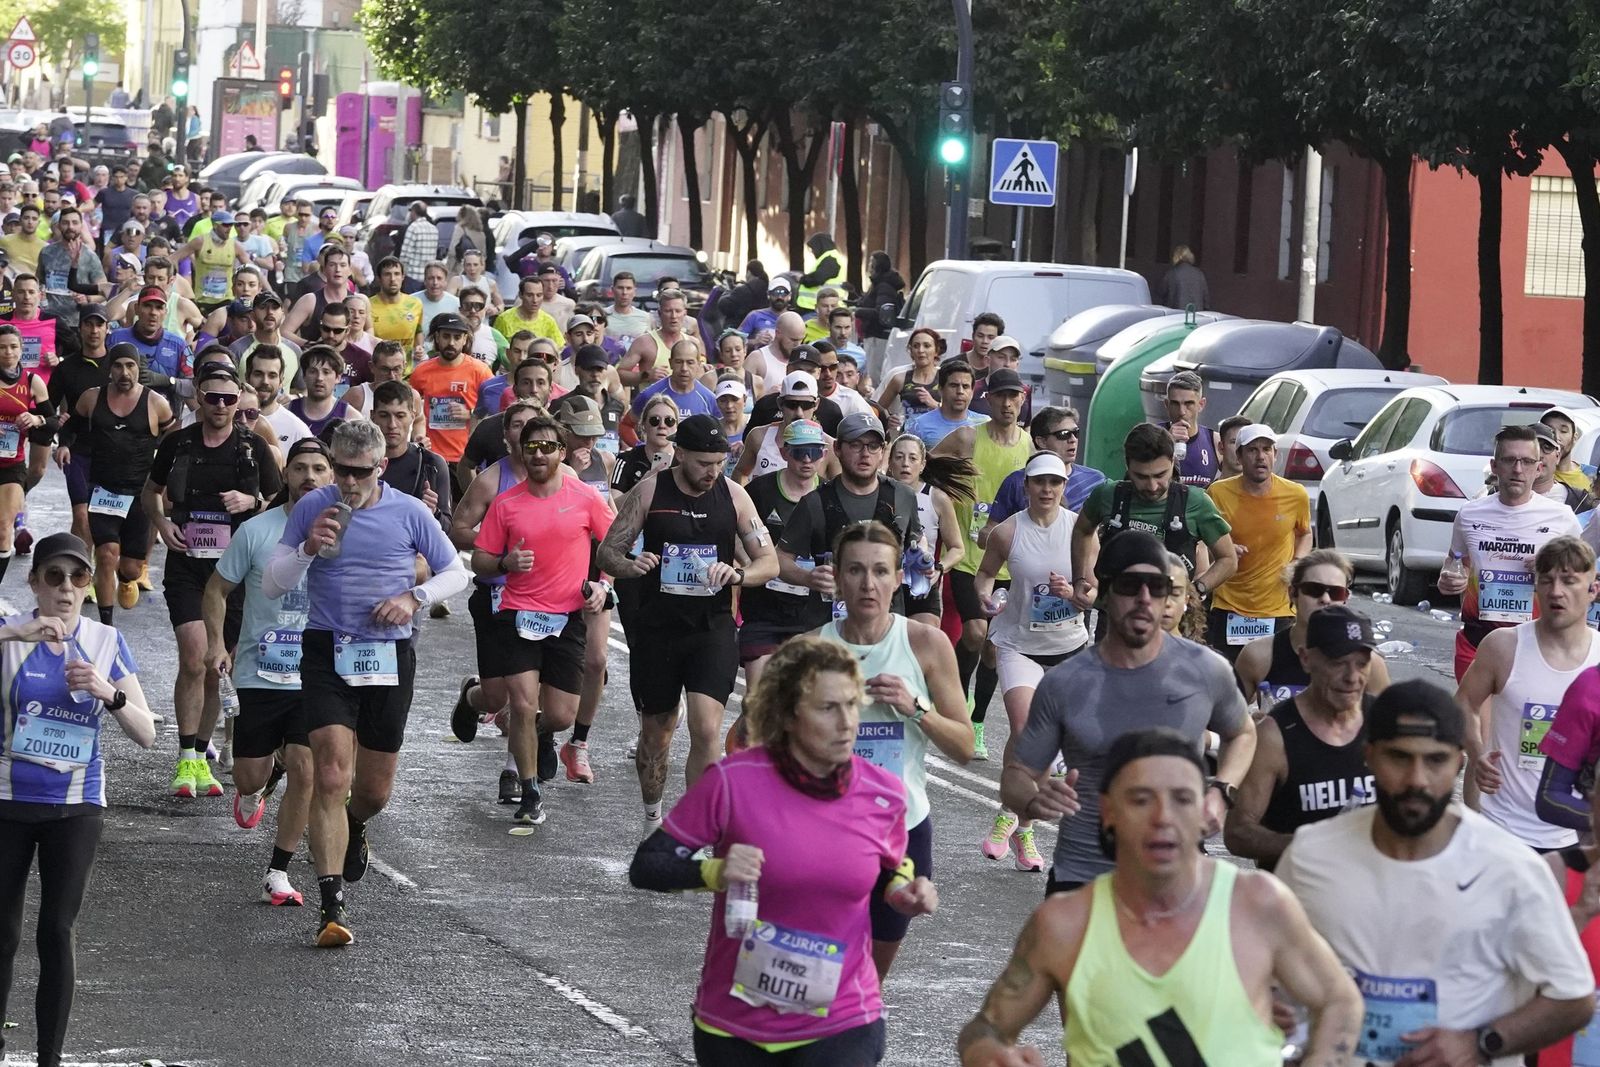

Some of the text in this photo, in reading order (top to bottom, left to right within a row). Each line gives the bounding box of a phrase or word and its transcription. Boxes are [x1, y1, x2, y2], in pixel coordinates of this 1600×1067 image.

[14, 50, 30, 61] 30
[98, 498, 124, 509] EMILIO
[192, 537, 217, 547] YANN
[1478, 541, 1536, 555] MARATHON
[1497, 571, 1529, 582] ZURICH
[1497, 588, 1514, 597] 7565
[1482, 598, 1529, 611] LAURENT
[1043, 607, 1071, 621] SILVIA
[1231, 625, 1270, 636] MONICHE
[260, 661, 283, 672] TIAGO
[353, 660, 380, 673] RICO
[43, 727, 66, 740] 8780
[23, 737, 80, 759] ZOUZOU
[758, 972, 808, 1001] RUTH
